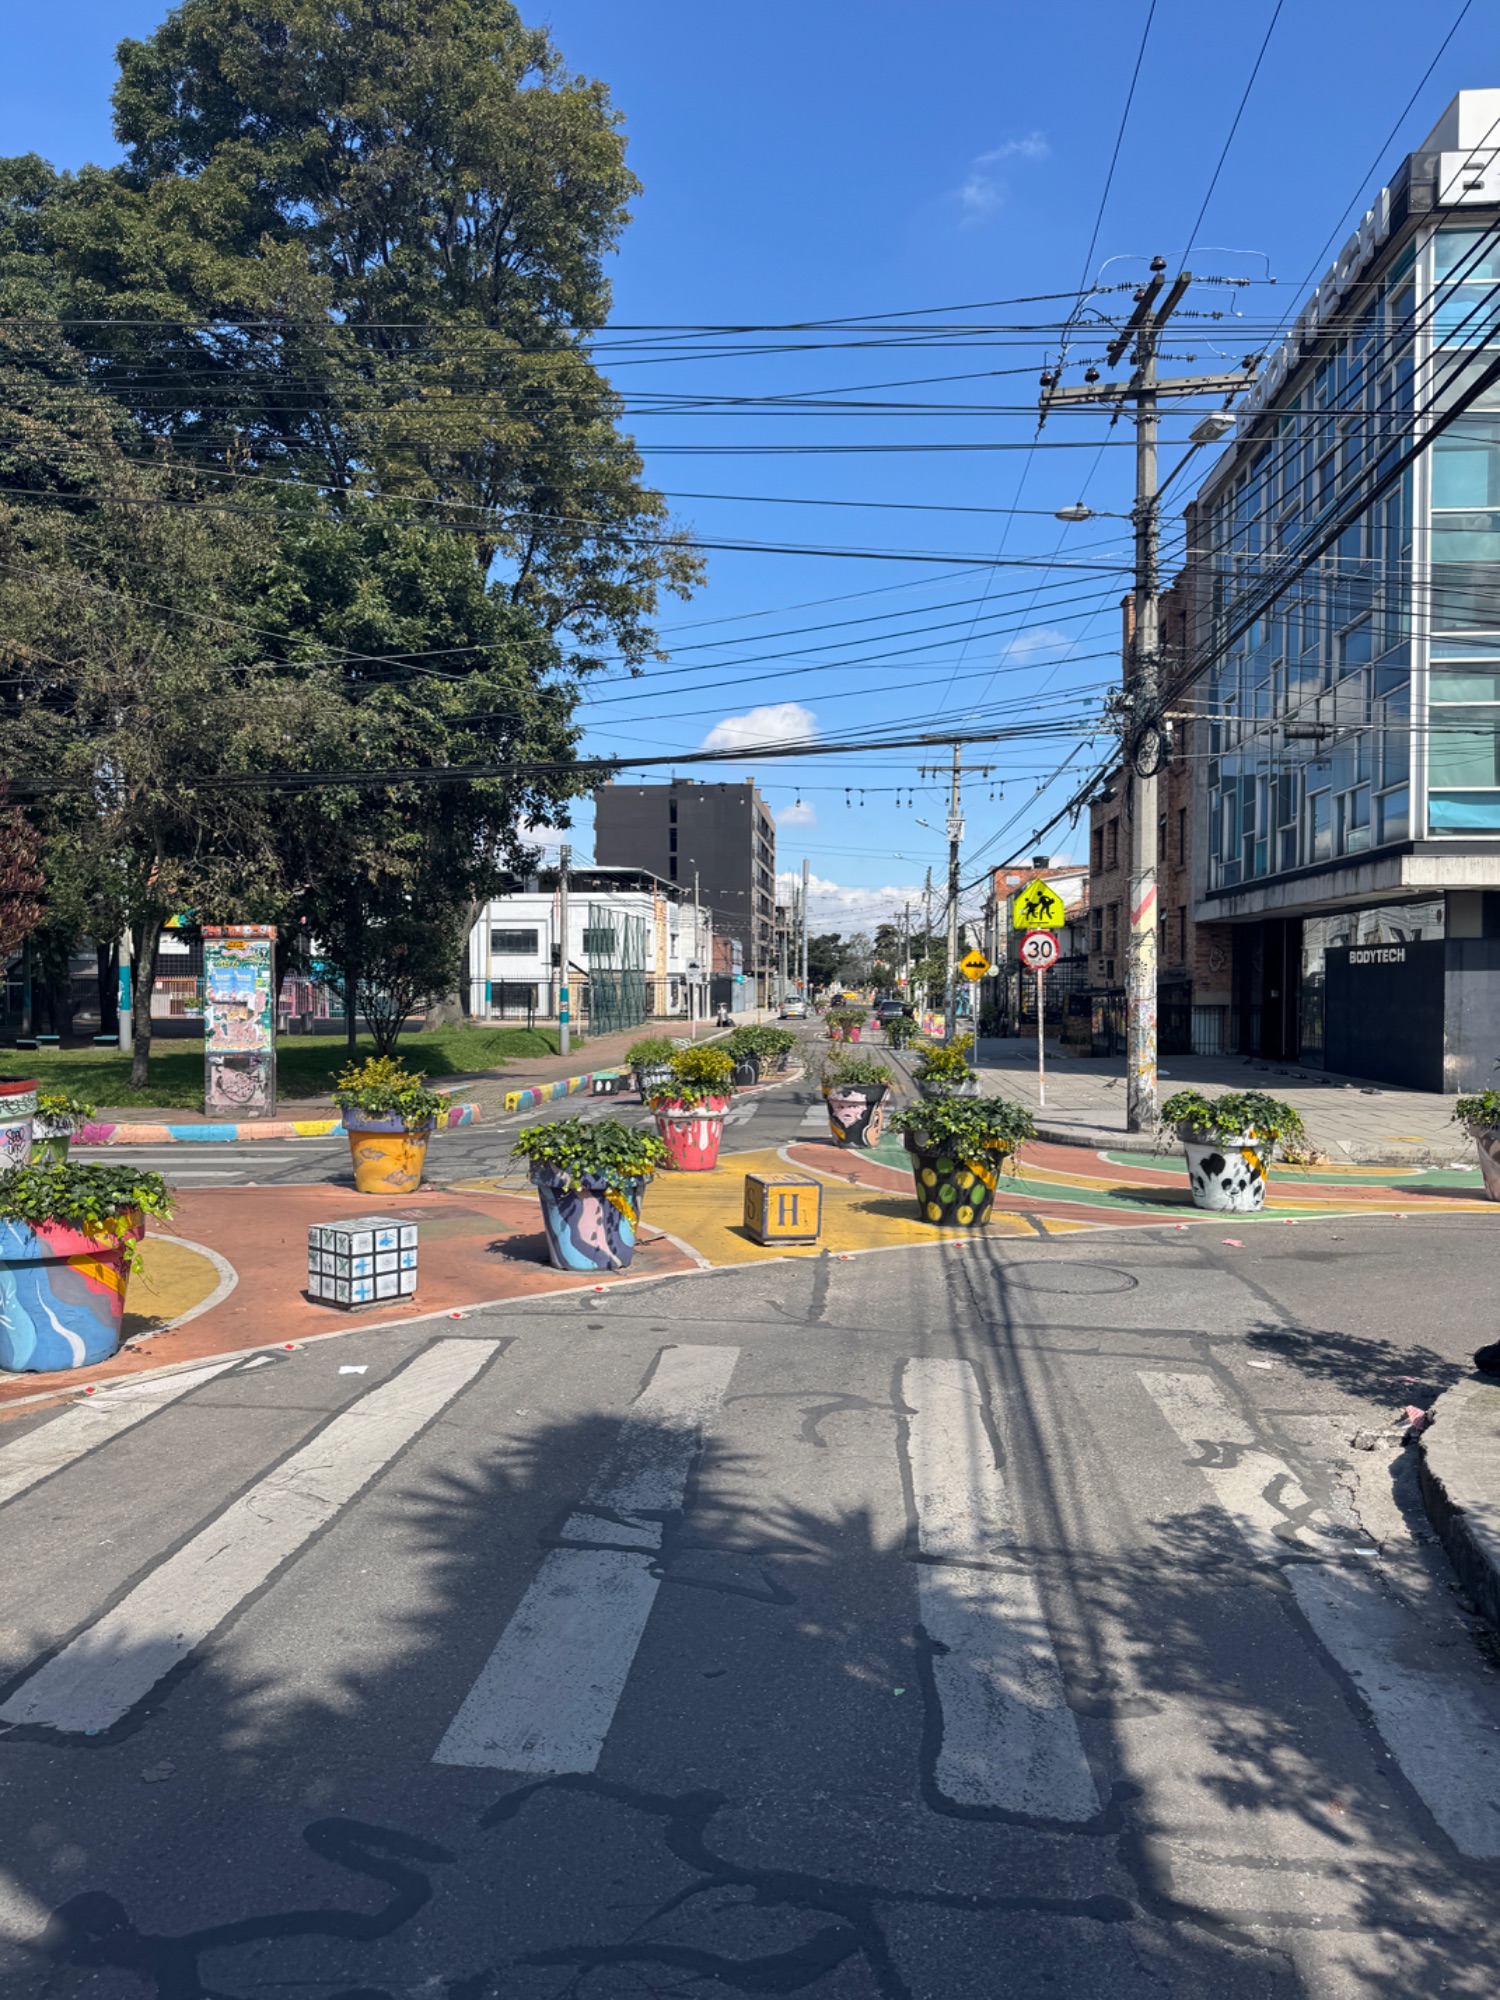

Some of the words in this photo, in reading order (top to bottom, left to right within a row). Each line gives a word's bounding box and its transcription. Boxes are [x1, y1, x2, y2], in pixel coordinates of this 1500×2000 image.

[1028, 940, 1053, 958] 30
[1349, 947, 1406, 964] BODYTECH
[778, 1193, 799, 1226] H
